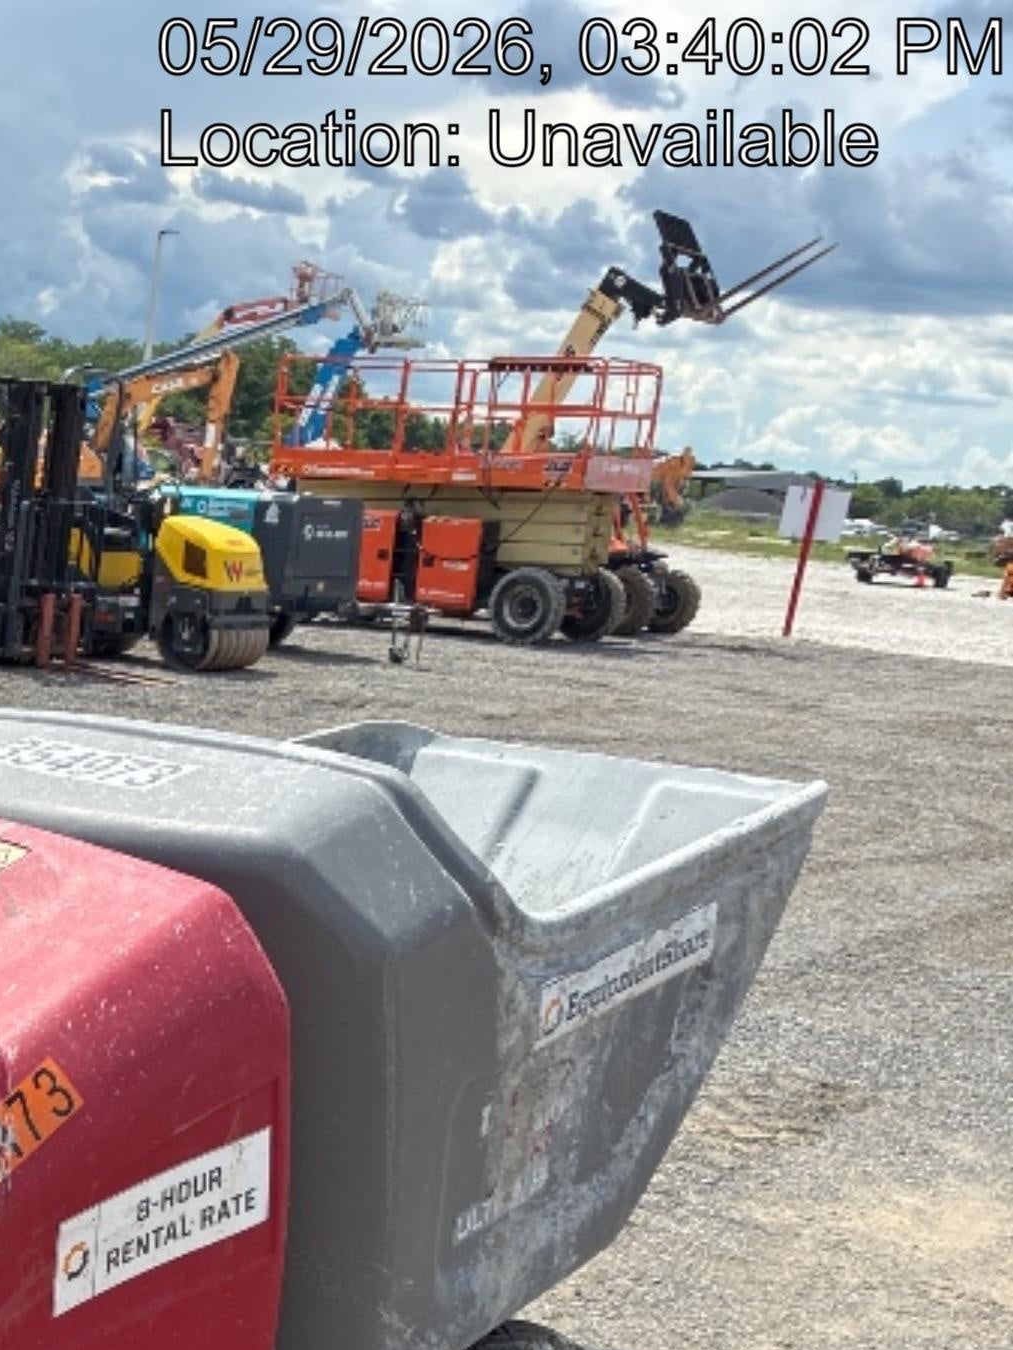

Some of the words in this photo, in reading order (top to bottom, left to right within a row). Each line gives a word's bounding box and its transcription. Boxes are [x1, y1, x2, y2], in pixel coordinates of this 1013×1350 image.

[136, 1165, 223, 1222] 8-HOUR
[106, 1212, 193, 1274] RENTAL
[199, 1186, 257, 1231] RATE
